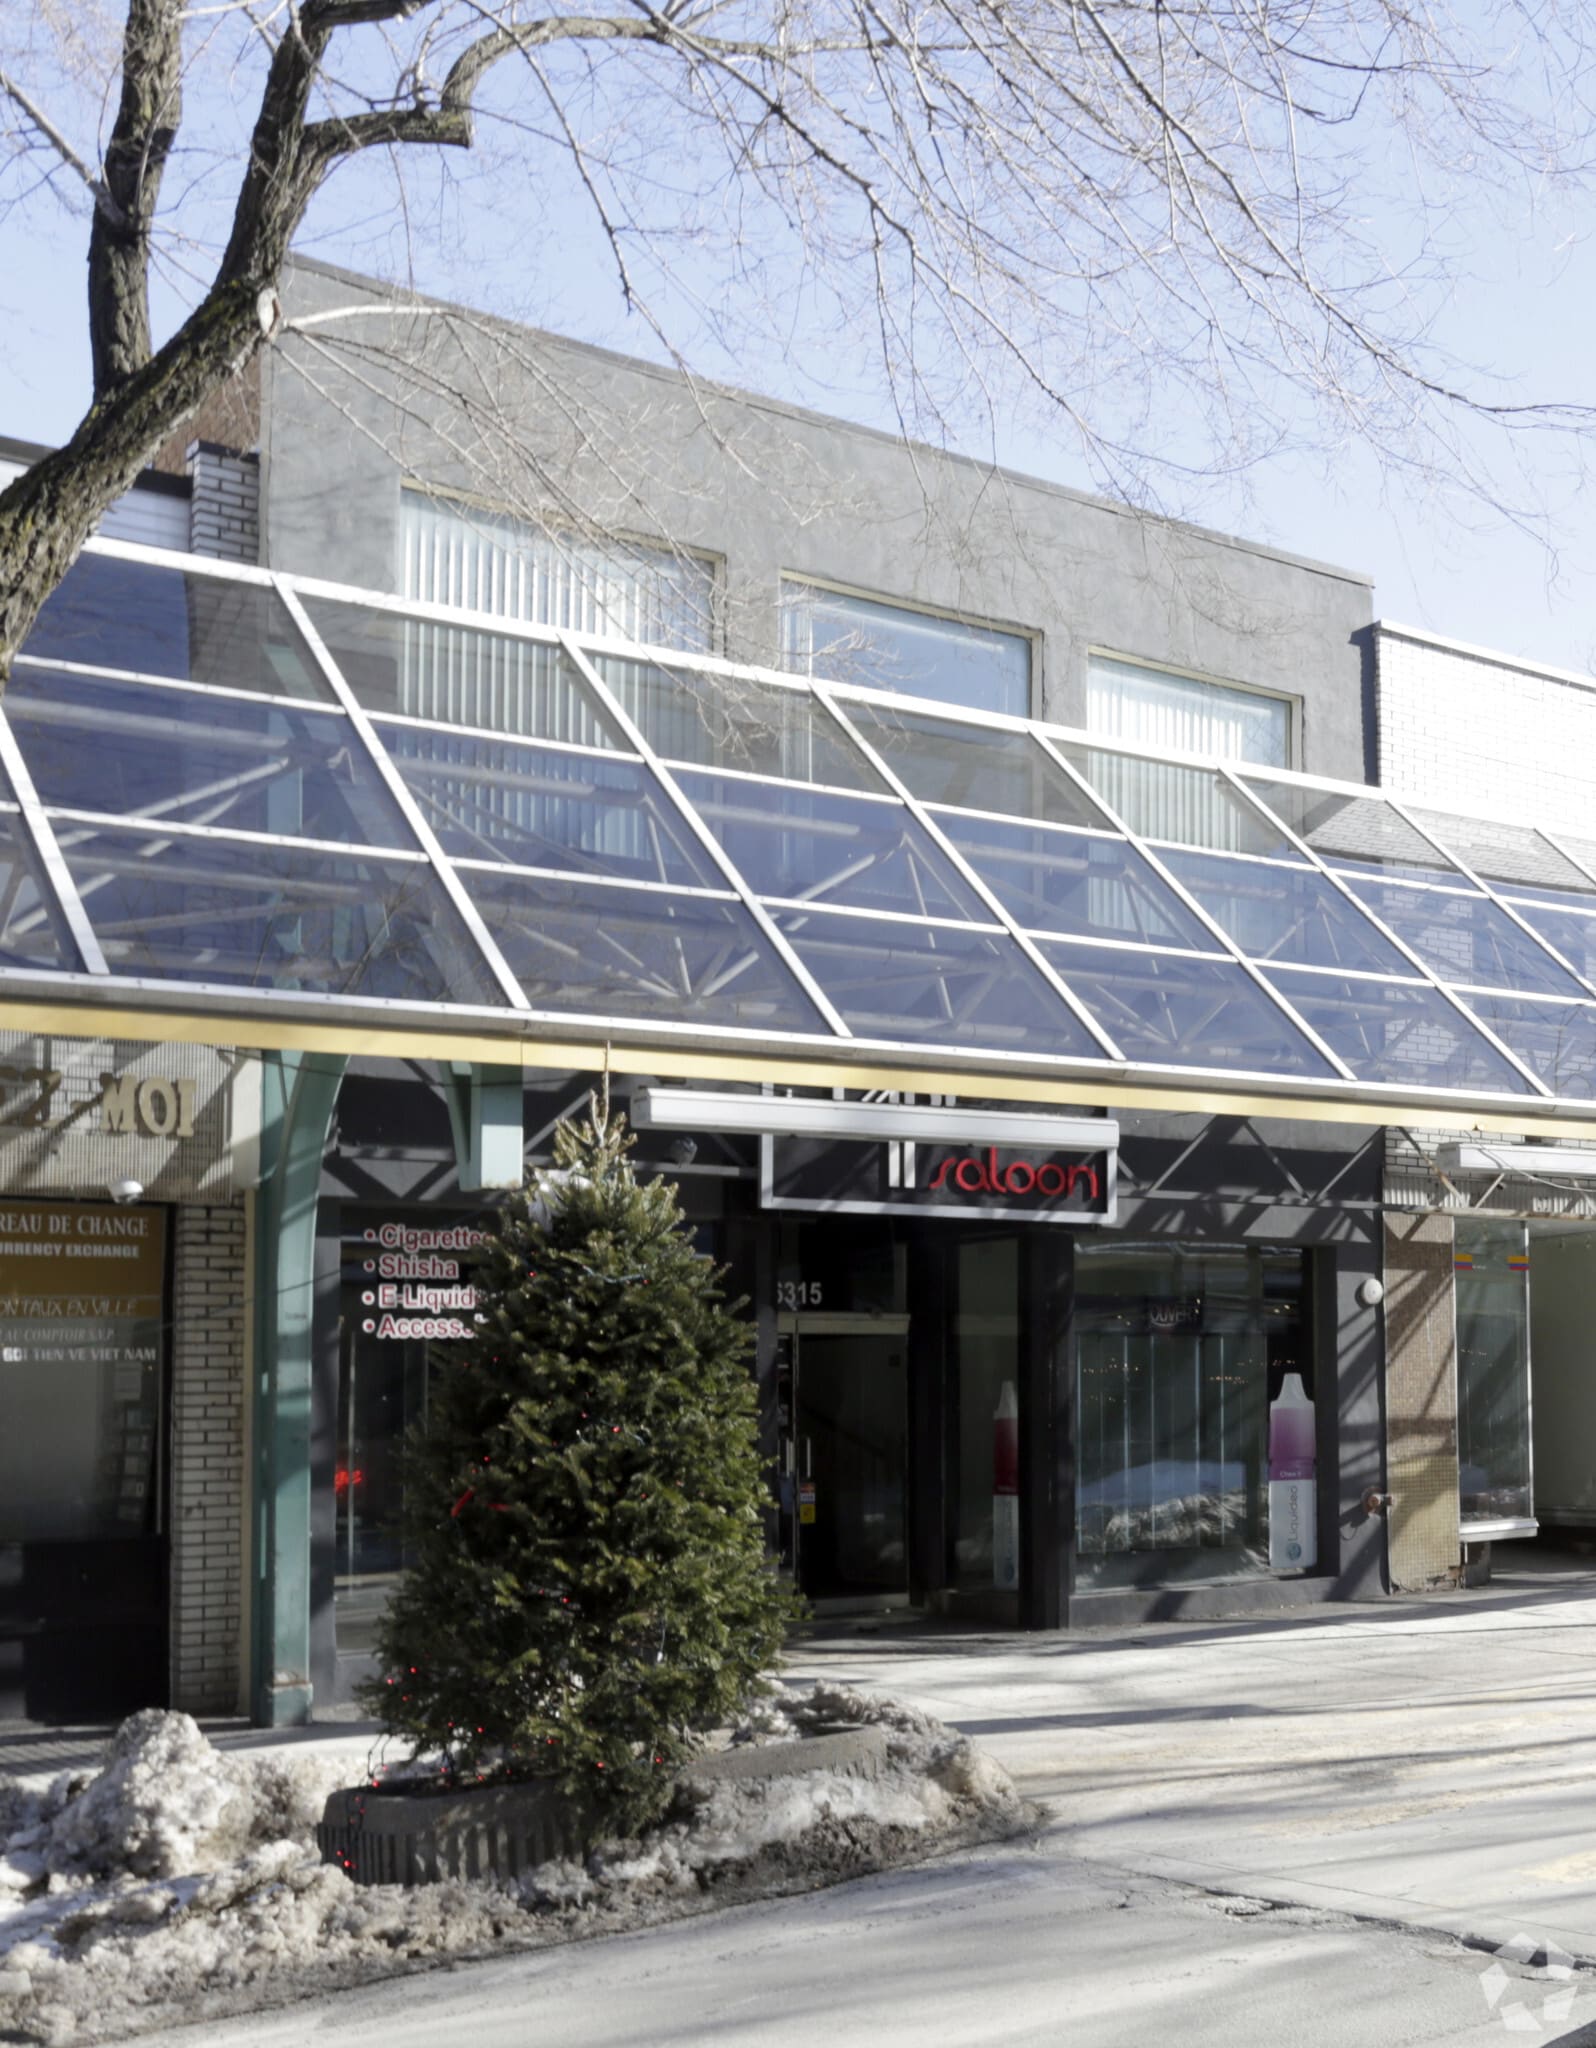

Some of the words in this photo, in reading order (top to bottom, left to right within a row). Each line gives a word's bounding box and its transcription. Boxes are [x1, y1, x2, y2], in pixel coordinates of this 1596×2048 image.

[929, 1145, 1098, 1198] saloon
[48, 1213, 72, 1235] DE
[76, 1215, 149, 1237] CHANGE
[66, 1243, 140, 1258] EXCHANGE
[378, 1254, 459, 1279] Shisha
[66, 1298, 88, 1316] EN
[92, 1297, 138, 1317] VILLE
[24, 1327, 86, 1343] COMPTOIR
[124, 1347, 157, 1361] NAM
